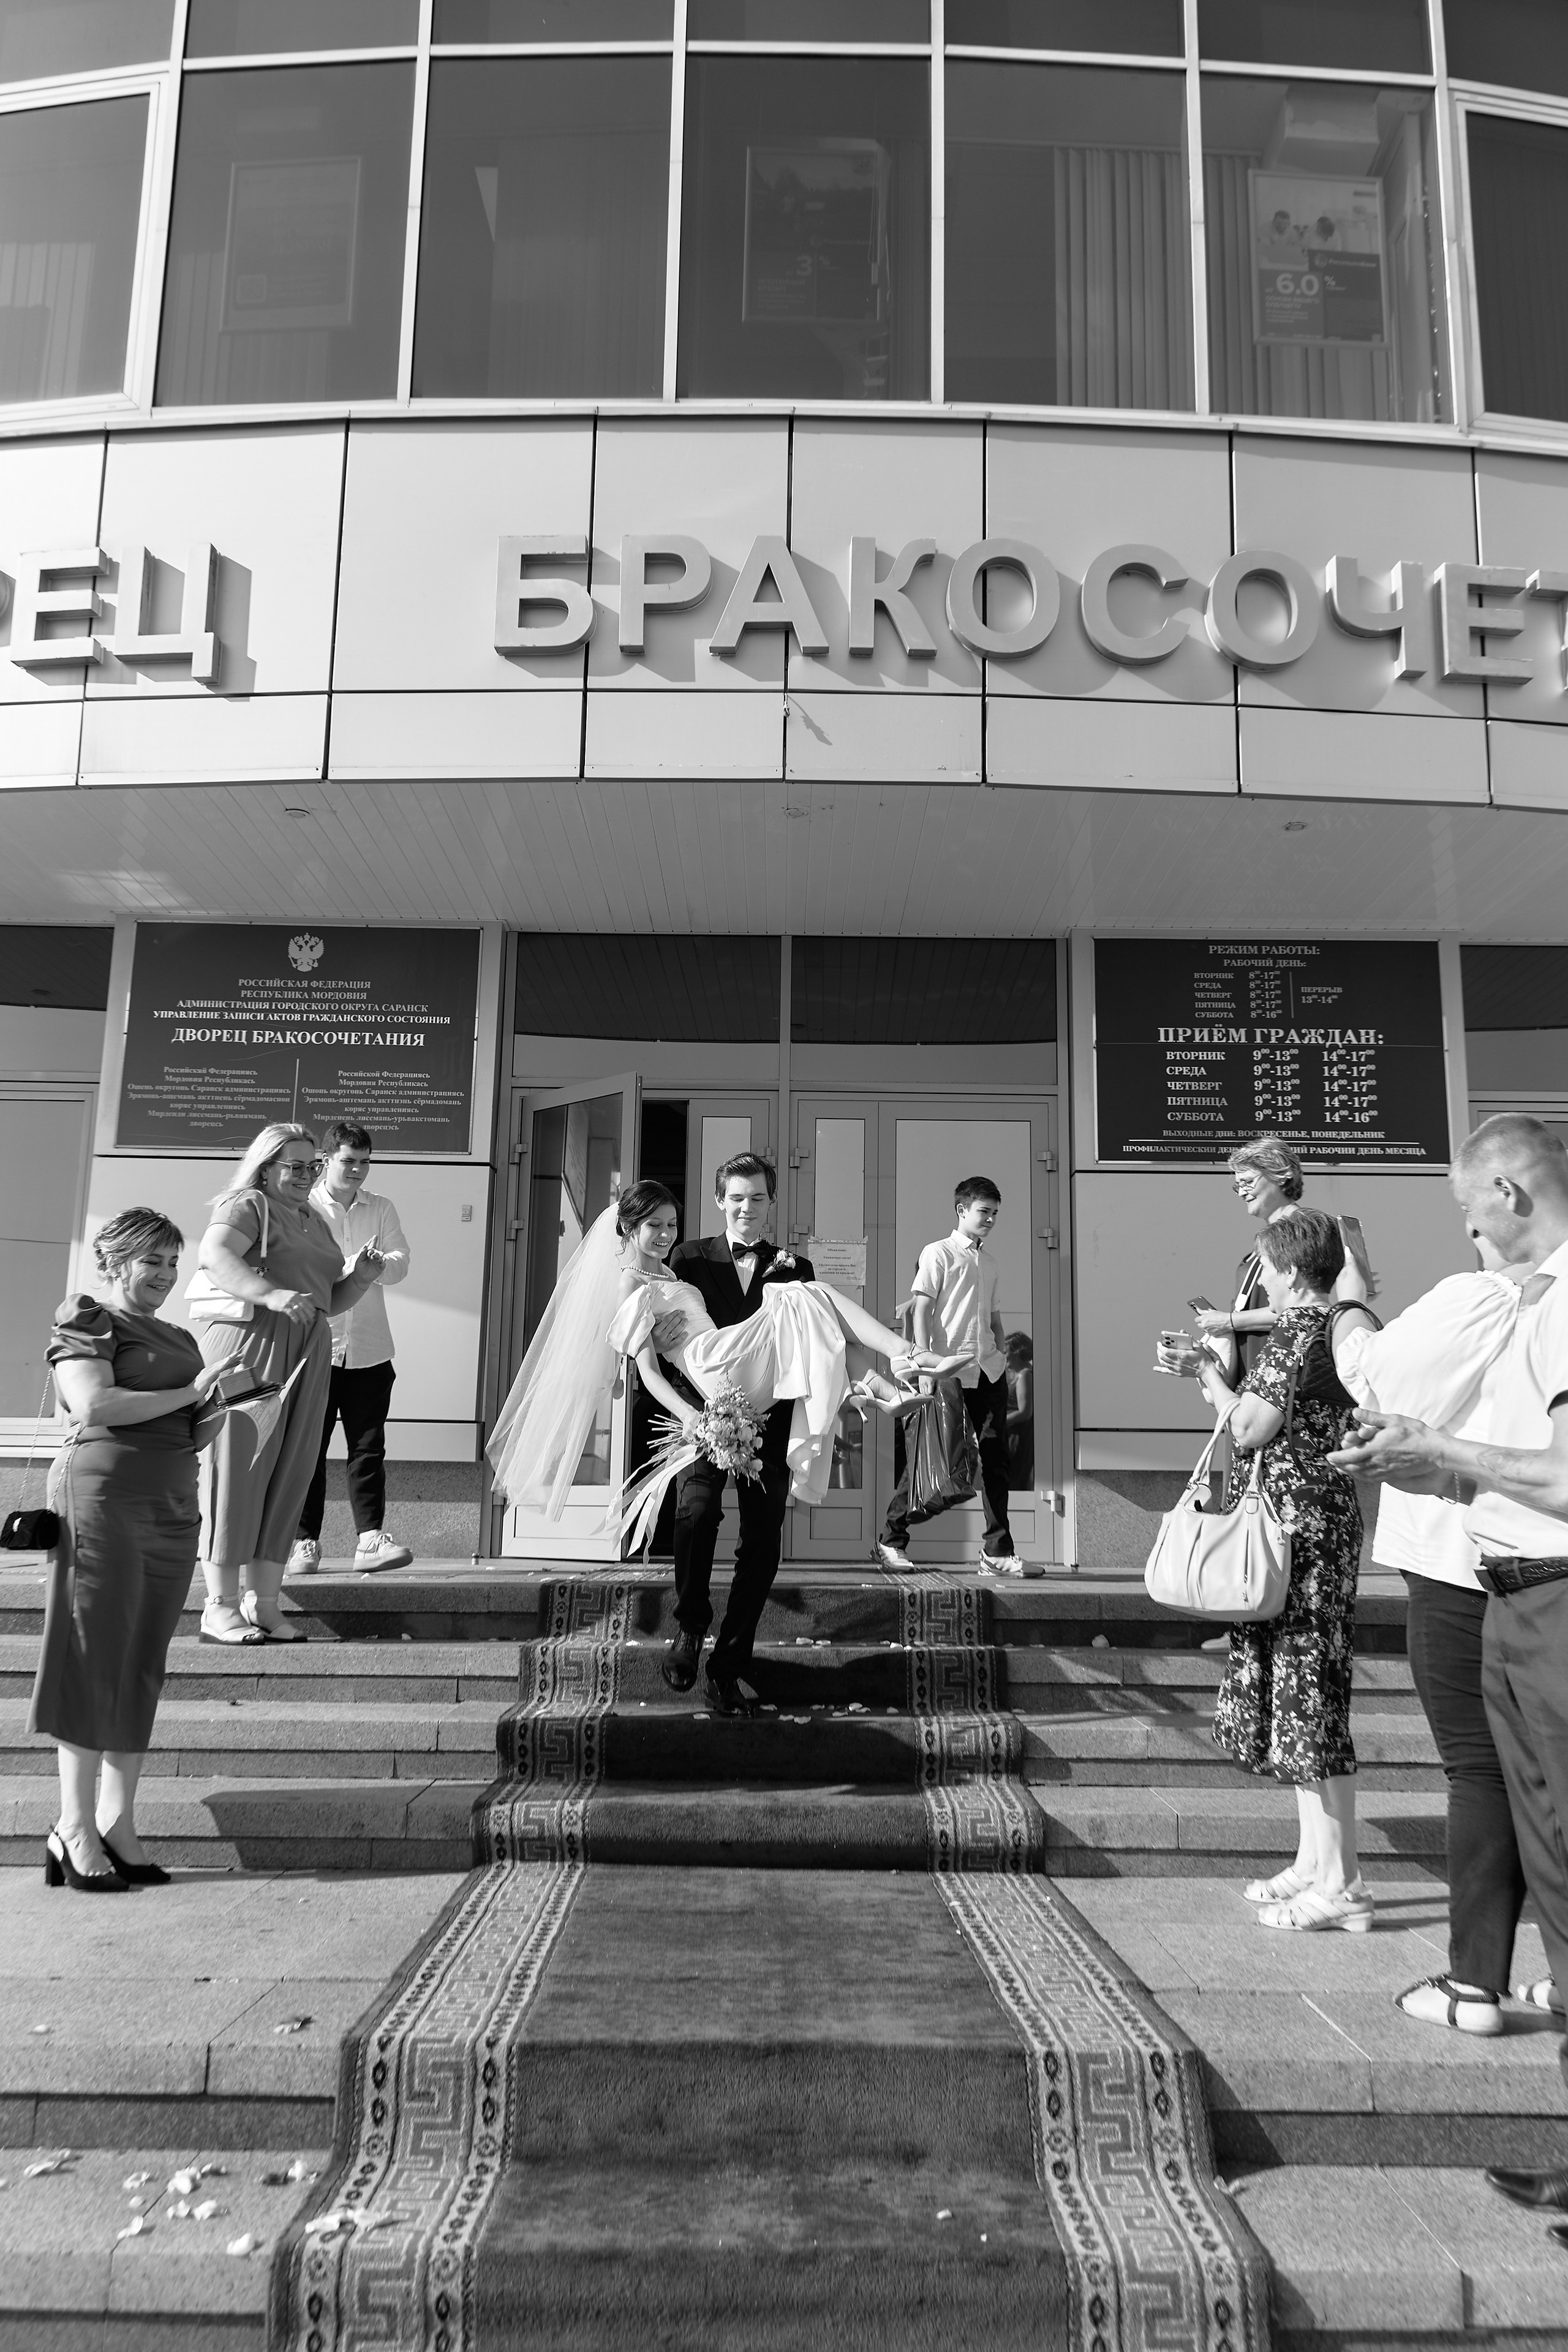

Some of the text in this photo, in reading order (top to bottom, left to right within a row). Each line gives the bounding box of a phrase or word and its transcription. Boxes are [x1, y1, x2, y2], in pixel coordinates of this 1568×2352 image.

[796, 255, 812, 276] 3
[1276, 273, 1319, 296] 6.0
[1324, 275, 1336, 287] %
[0, 542, 222, 685] ЕЦ
[1262, 946, 1320, 954] РАБОТЫ:
[239, 978, 371, 989] РОССИЙСКАЯ ФЕДЕРАЦИЯ
[177, 1000, 269, 1009] АДМИНИСТРАЦИЯ
[272, 1002, 338, 1011] ГОРОДСКОГО
[172, 1028, 424, 1046] ДВОРЕЦ БРАКОСОЧЕТАНИЯ
[1158, 1024, 1383, 1048] ПРИЁМ ГРАЖДАН:
[1166, 1066, 1207, 1077] СРЕДА
[205, 1076, 255, 1084] Республикась
[1167, 1097, 1228, 1107] ПЯТНИЦА
[1167, 1112, 1224, 1121] СУББОТА
